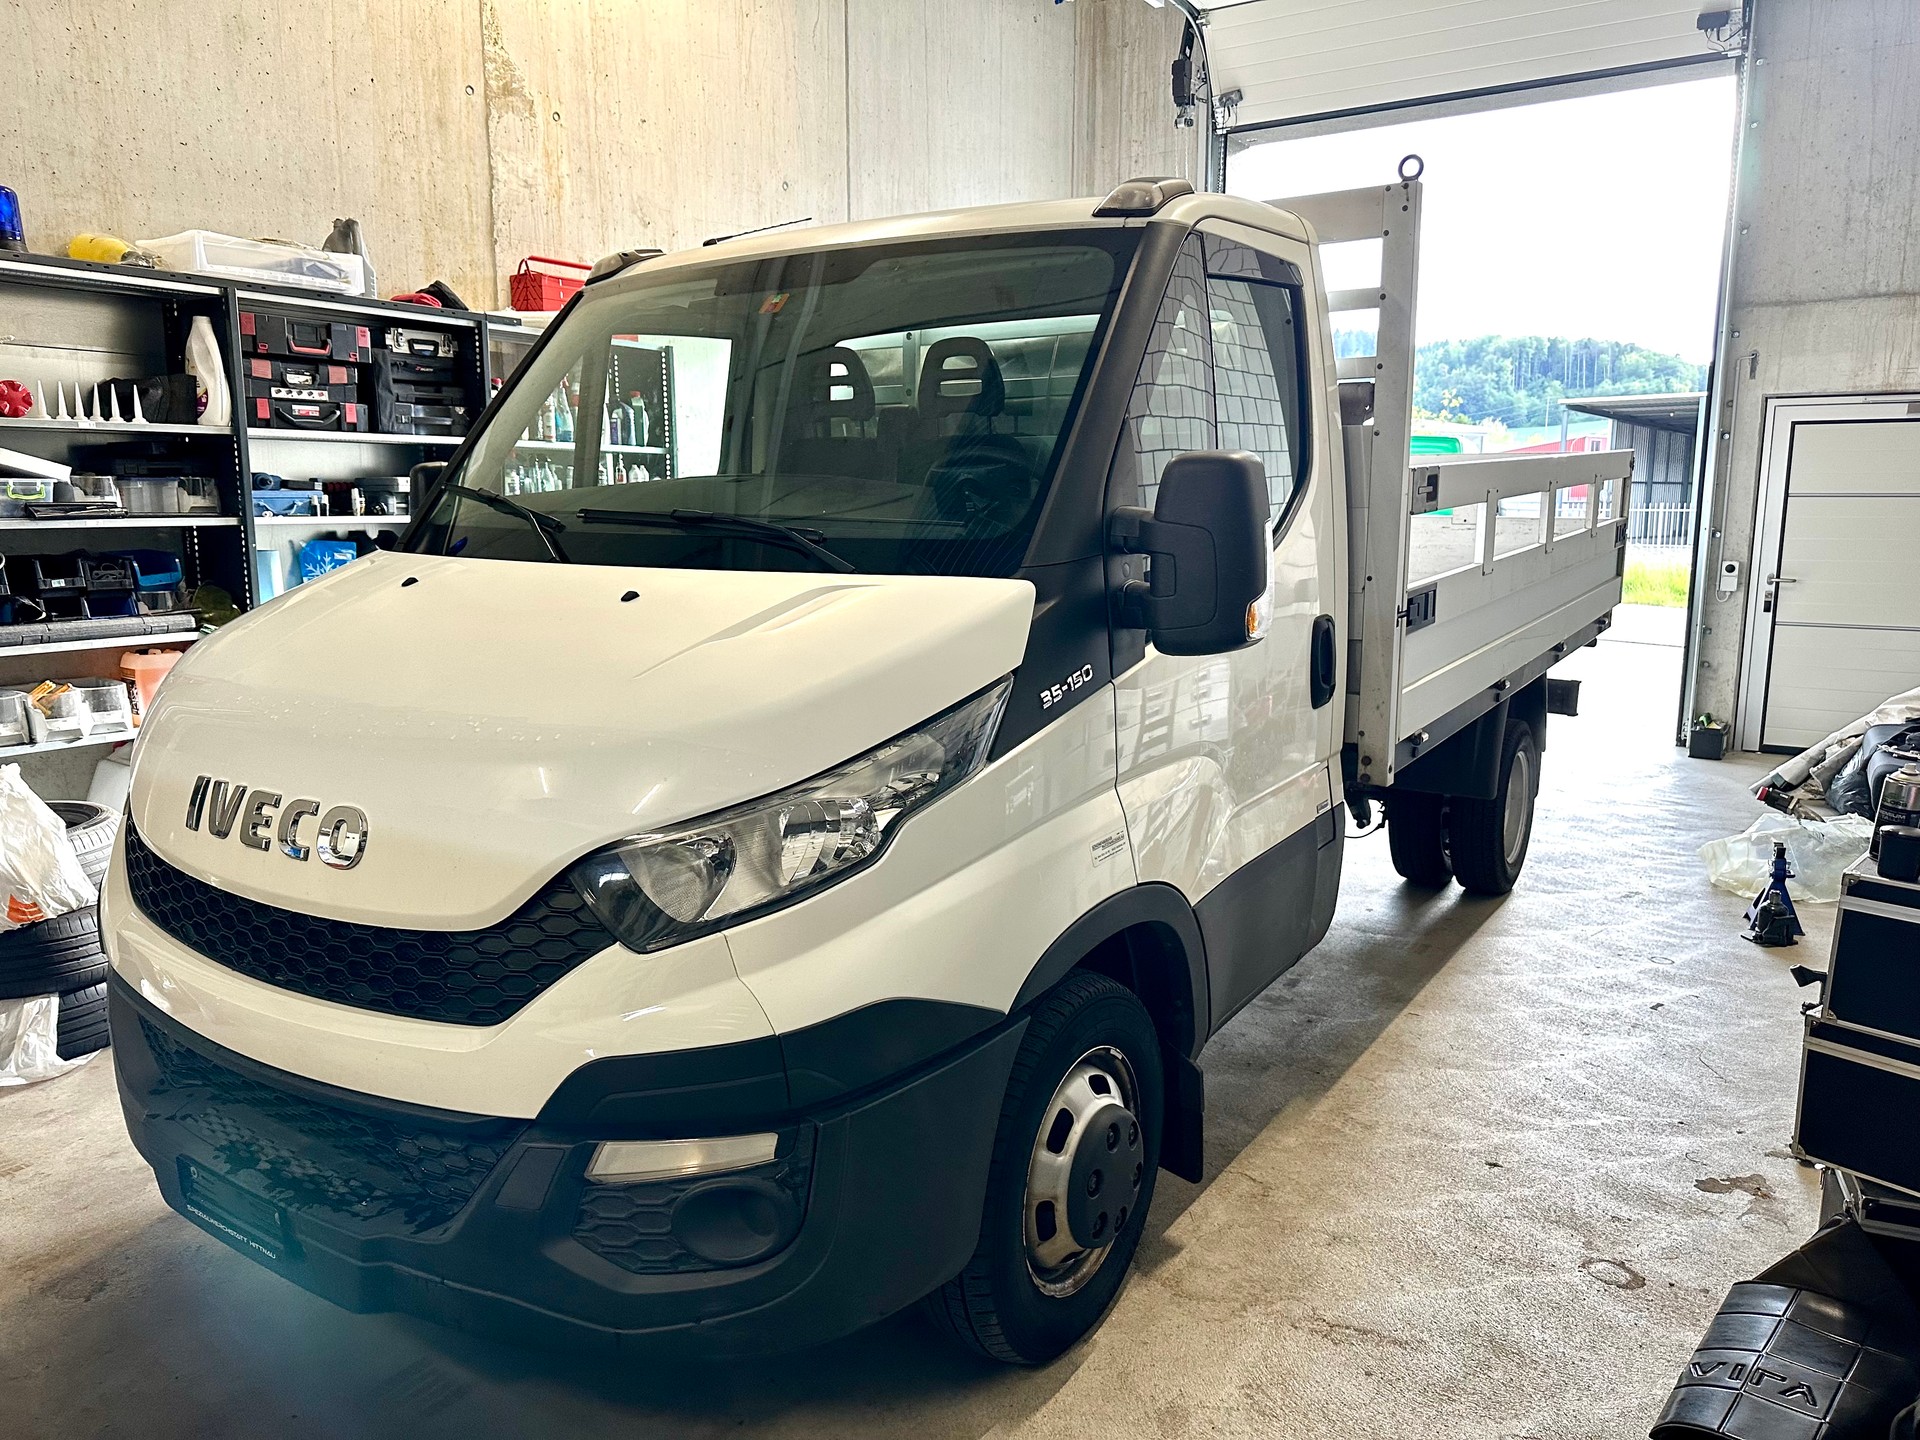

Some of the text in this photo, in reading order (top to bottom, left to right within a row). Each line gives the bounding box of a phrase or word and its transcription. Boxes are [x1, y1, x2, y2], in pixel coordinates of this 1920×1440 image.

[1040, 664, 1093, 710] 35-150
[185, 774, 369, 871] IVECO
[249, 1240, 276, 1260] HITTNAU
